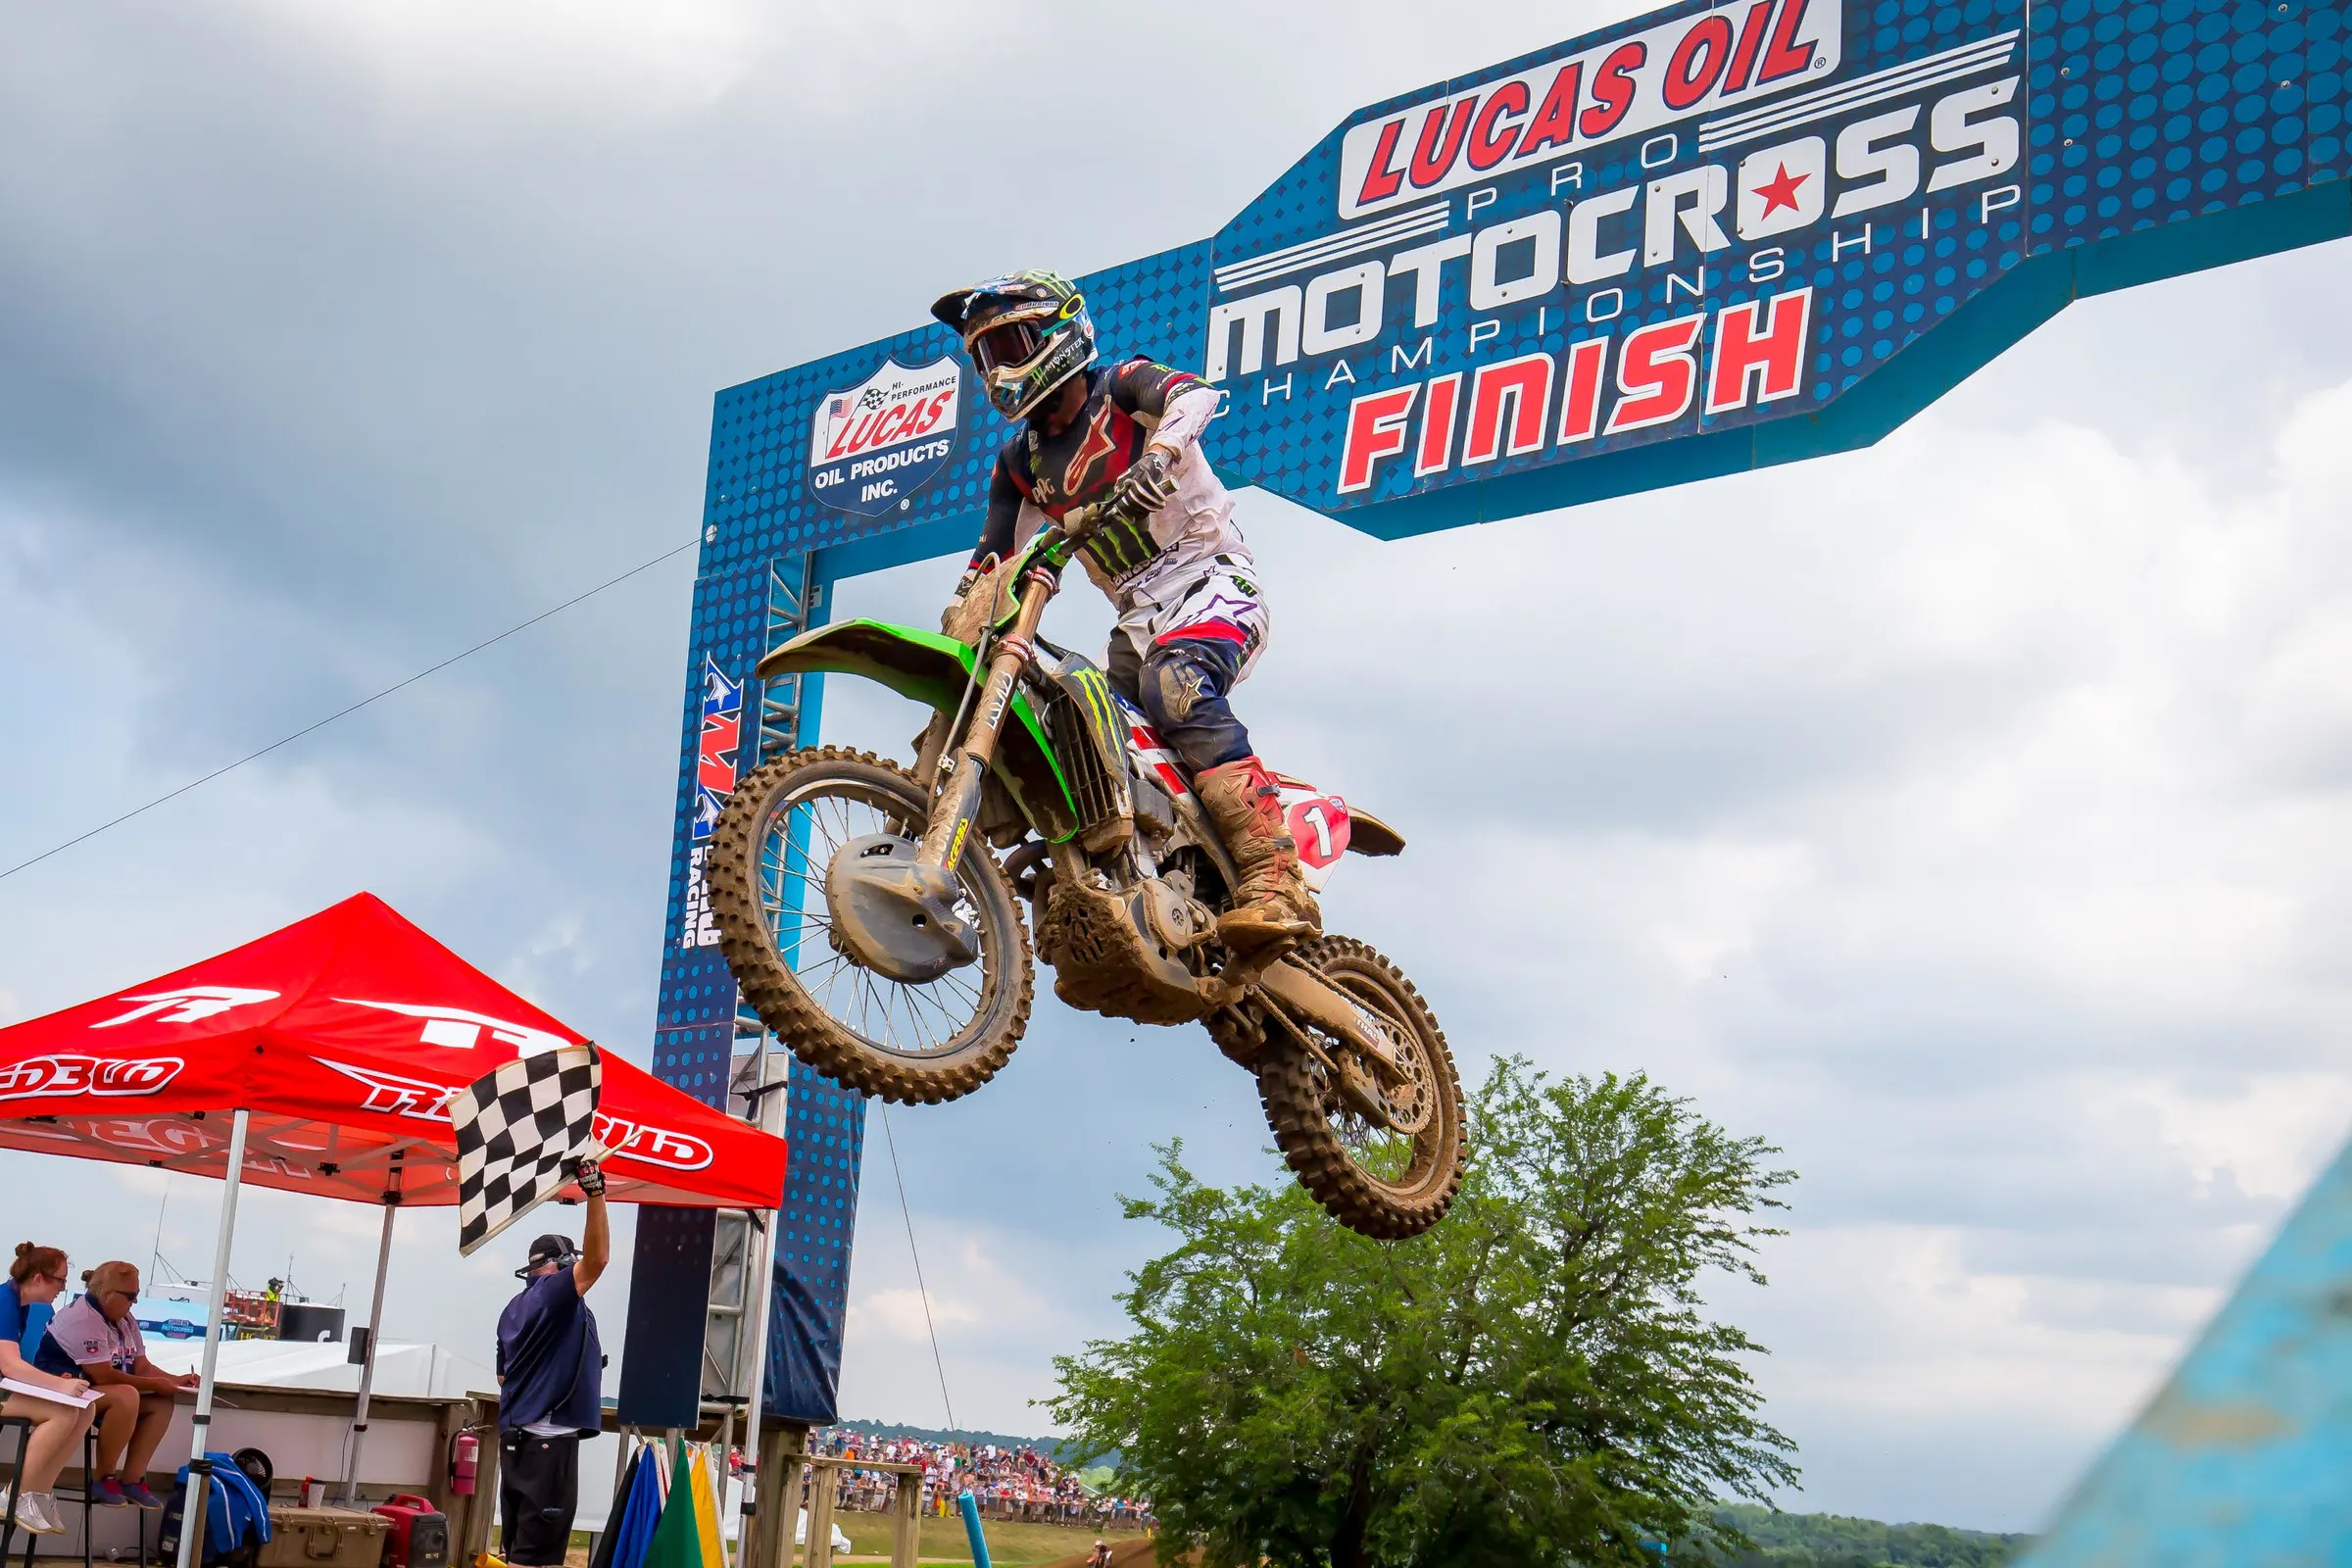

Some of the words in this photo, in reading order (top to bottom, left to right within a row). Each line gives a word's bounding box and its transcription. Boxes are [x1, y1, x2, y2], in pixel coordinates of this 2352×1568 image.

[1356, 40, 1647, 208] LUCAS
[1663, 0, 1821, 111] OIL
[1467, 133, 1678, 220] PRO
[1205, 75, 2019, 384] MOTOCROSS
[1212, 184, 2021, 417] CHAMPIONSHIP
[891, 376, 956, 401] PERFORMANCE
[892, 381, 905, 391] HI-
[1045, 337, 1084, 371] MONSTER
[1337, 286, 1813, 494] FINISH
[825, 388, 956, 460] LUCAS
[814, 469, 845, 489] OIL
[851, 439, 952, 480] PRODUCTS
[860, 479, 898, 503] INC.
[692, 651, 744, 840] AMA
[1302, 806, 1333, 858] 1
[683, 847, 704, 949] RACING
